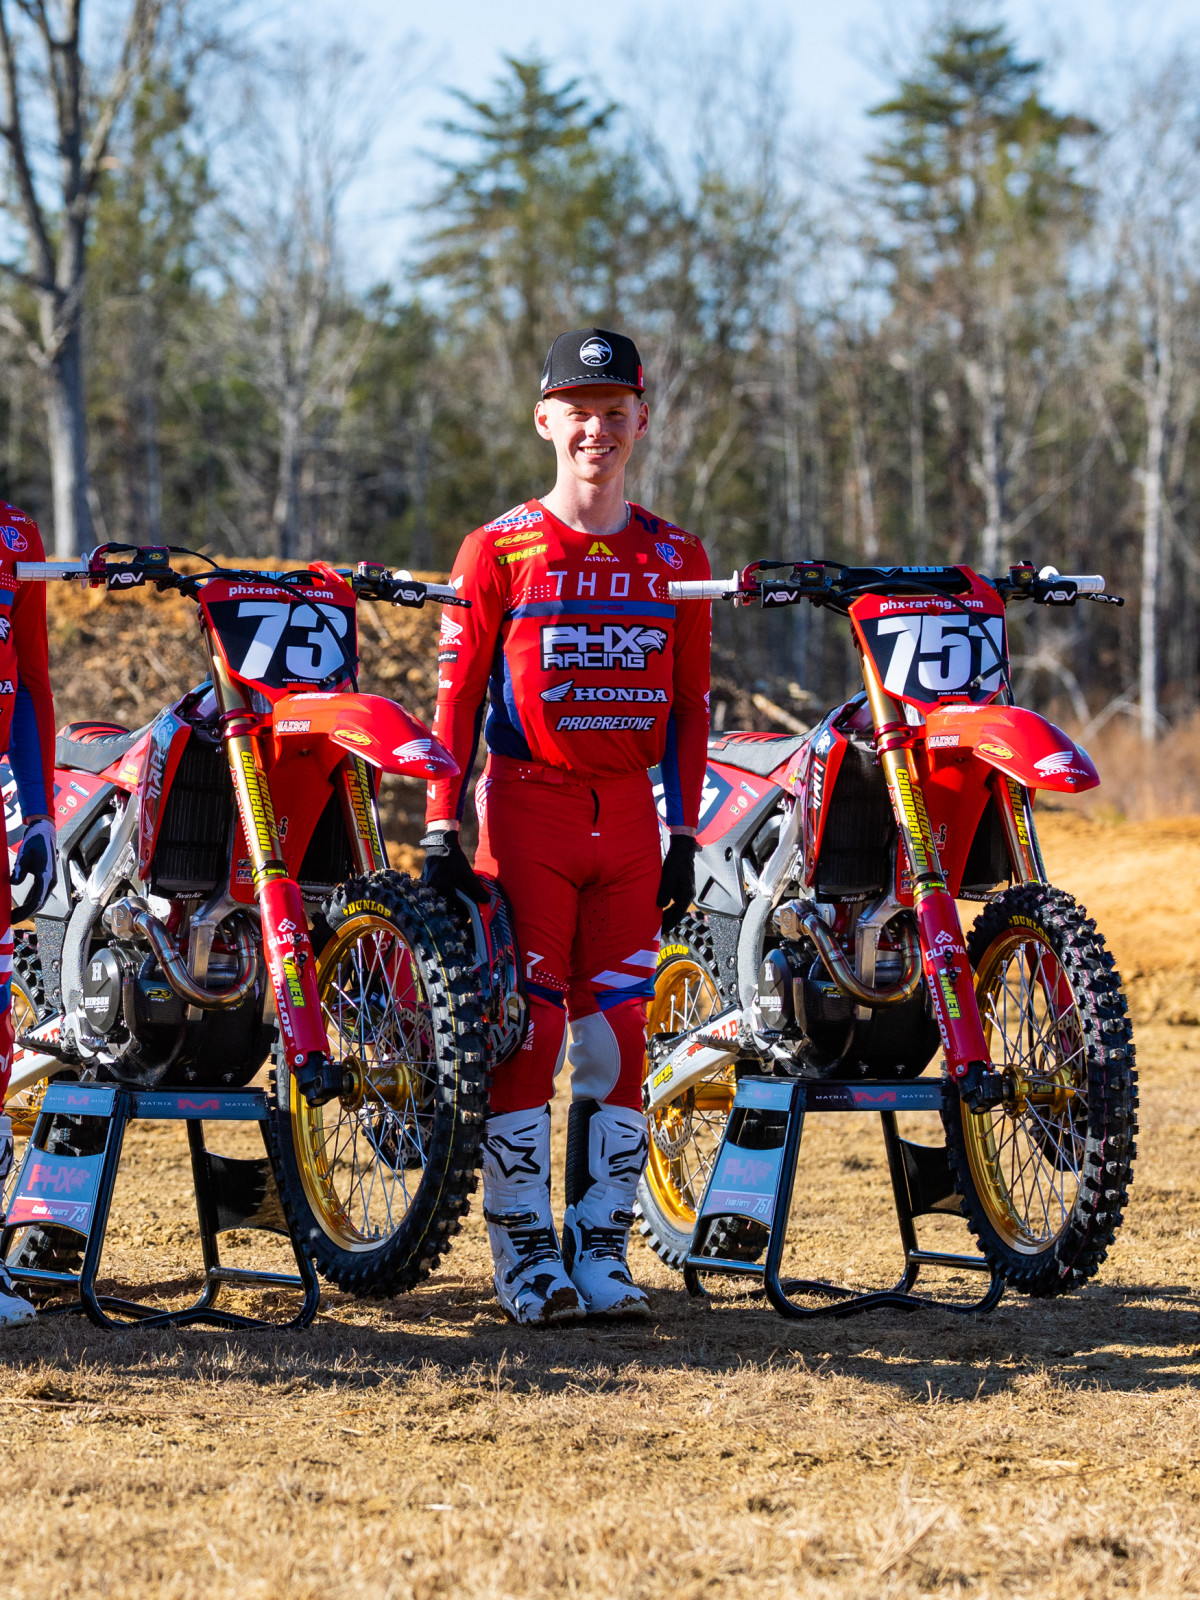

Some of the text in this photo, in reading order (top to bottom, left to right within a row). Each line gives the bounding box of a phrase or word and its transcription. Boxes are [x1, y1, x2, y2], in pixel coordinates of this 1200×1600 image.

[0, 525, 20, 549] VP
[494, 531, 544, 548] FMF
[497, 544, 548, 565] TAMER
[655, 542, 675, 564] VP
[110, 571, 144, 584] ASV
[393, 588, 426, 602] ASV
[437, 596, 459, 604] ASV
[765, 591, 798, 603] ASV
[1043, 590, 1077, 601] ASV
[1088, 593, 1116, 603] ASV
[237, 601, 348, 680] 73
[542, 625, 645, 653] PHX
[543, 653, 645, 669] RACING
[877, 614, 1003, 697] 751
[573, 688, 669, 702] HONDA
[556, 716, 656, 731] PROGRESSIVE
[398, 755, 448, 765] HONDA
[1039, 767, 1090, 778] HONDA
[962, 891, 992, 901] Twin Air
[348, 899, 392, 918] DUNLOP
[91, 962, 102, 981] H
[268, 962, 293, 1038] DUNLOP
[927, 974, 951, 1050] DUNLOP
[26, 1164, 77, 1194] PHX
[721, 1157, 762, 1186] PHX
[752, 1197, 772, 1214] 751
[68, 1206, 88, 1223] 73
